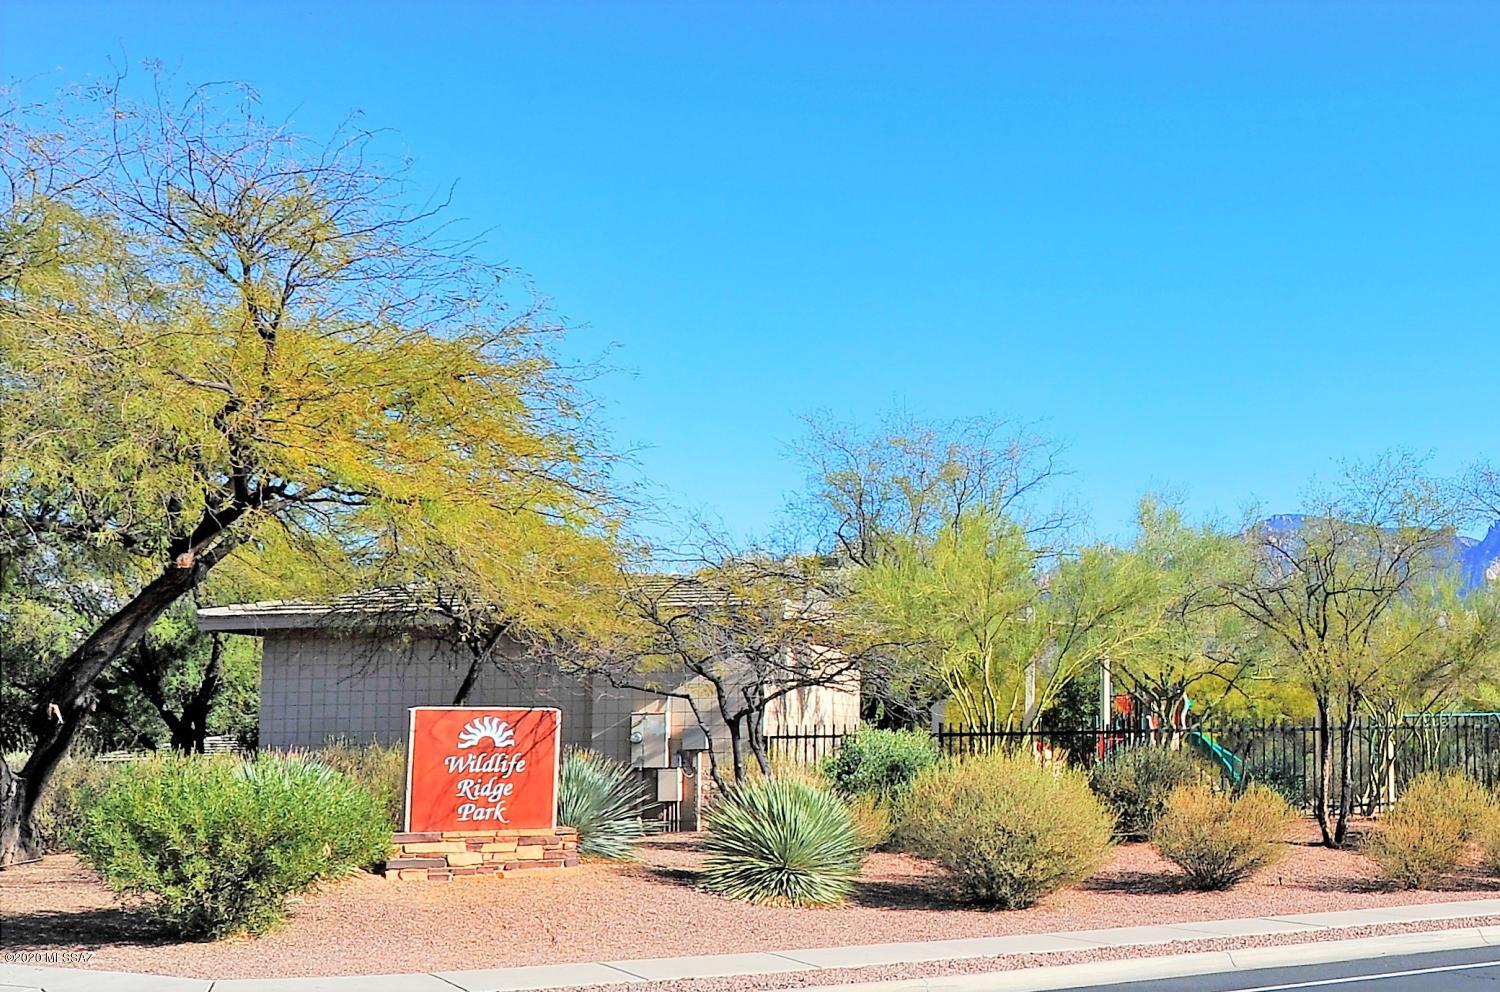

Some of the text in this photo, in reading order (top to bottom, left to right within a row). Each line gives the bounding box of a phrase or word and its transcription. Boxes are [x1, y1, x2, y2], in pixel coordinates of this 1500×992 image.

[444, 752, 526, 778] Wildlife
[456, 777, 514, 802] Ridge
[456, 800, 510, 823] Park
